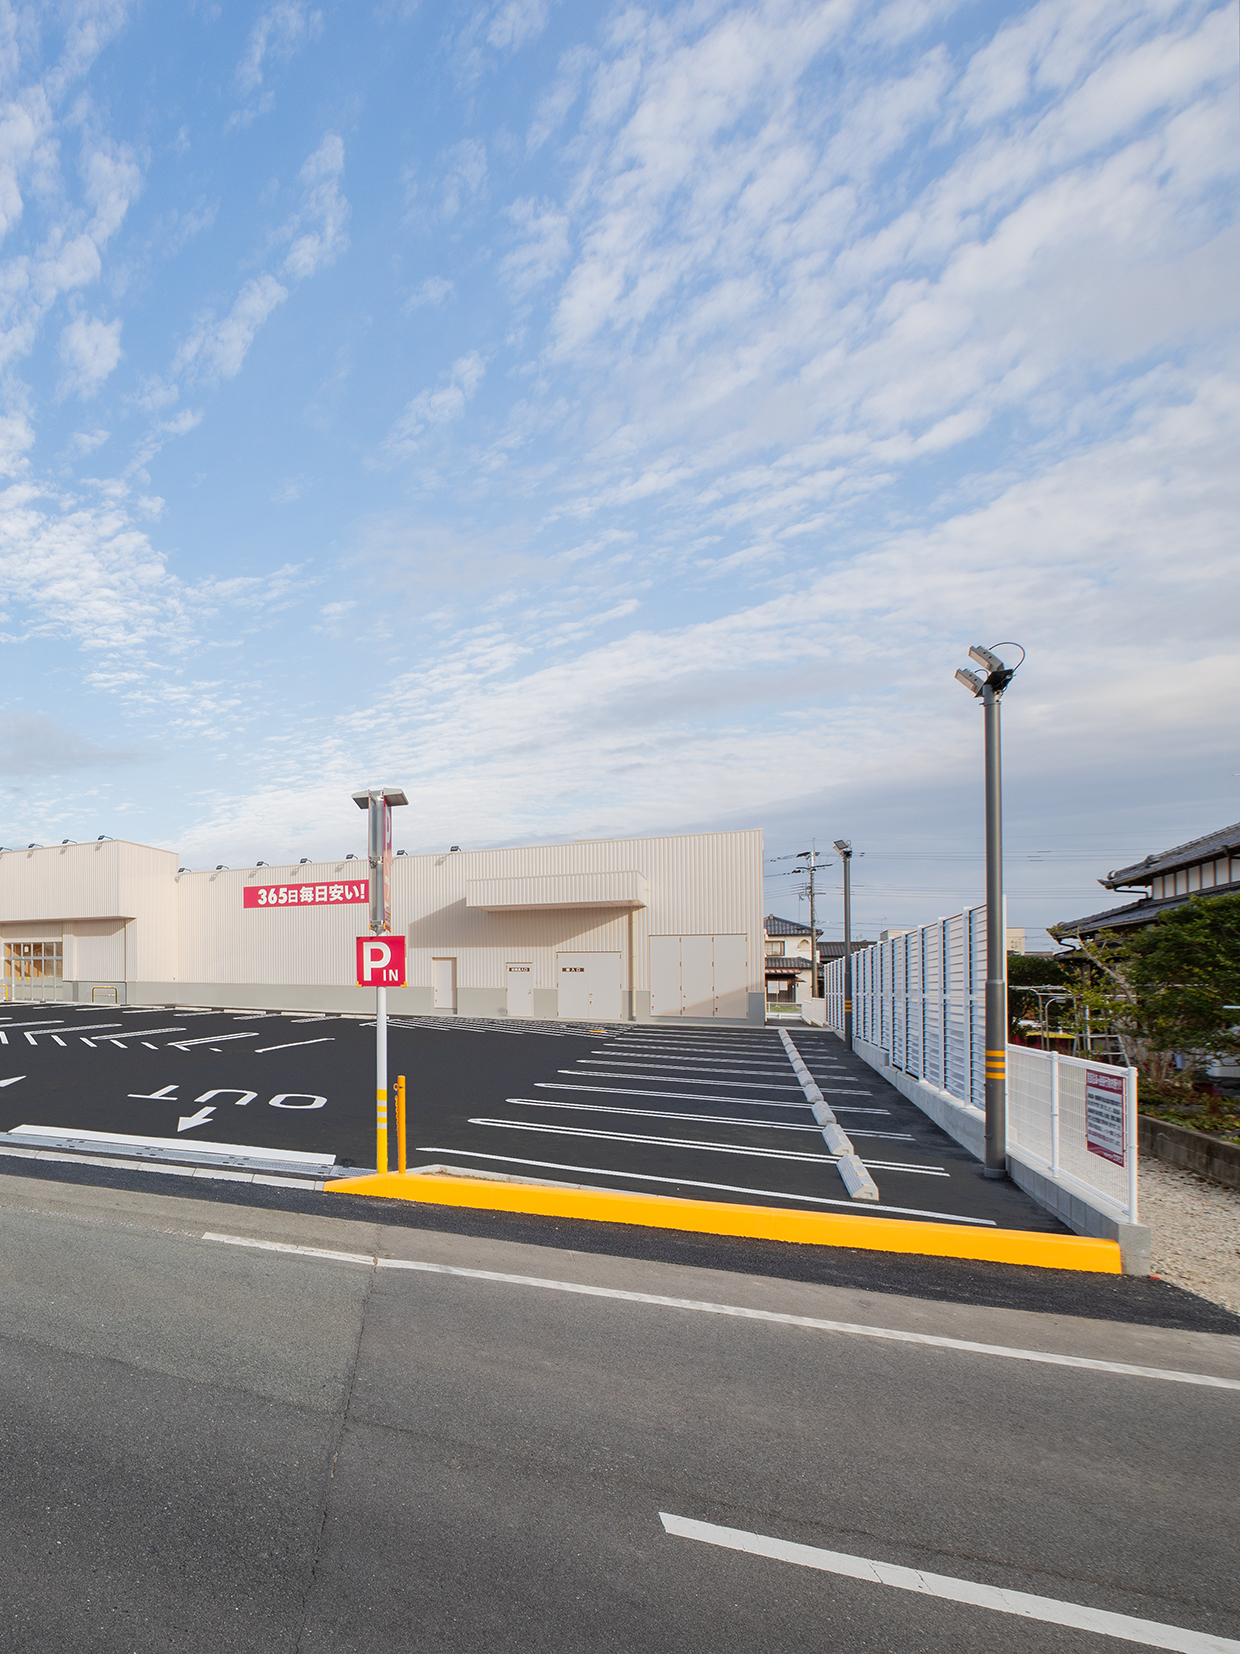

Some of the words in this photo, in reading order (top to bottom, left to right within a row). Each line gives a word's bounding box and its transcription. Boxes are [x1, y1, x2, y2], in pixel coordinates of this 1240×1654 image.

[257, 883, 366, 905] 365日毎日安い!
[363, 941, 391, 982] P
[383, 969, 399, 982] IN
[127, 1084, 328, 1110] OUT
